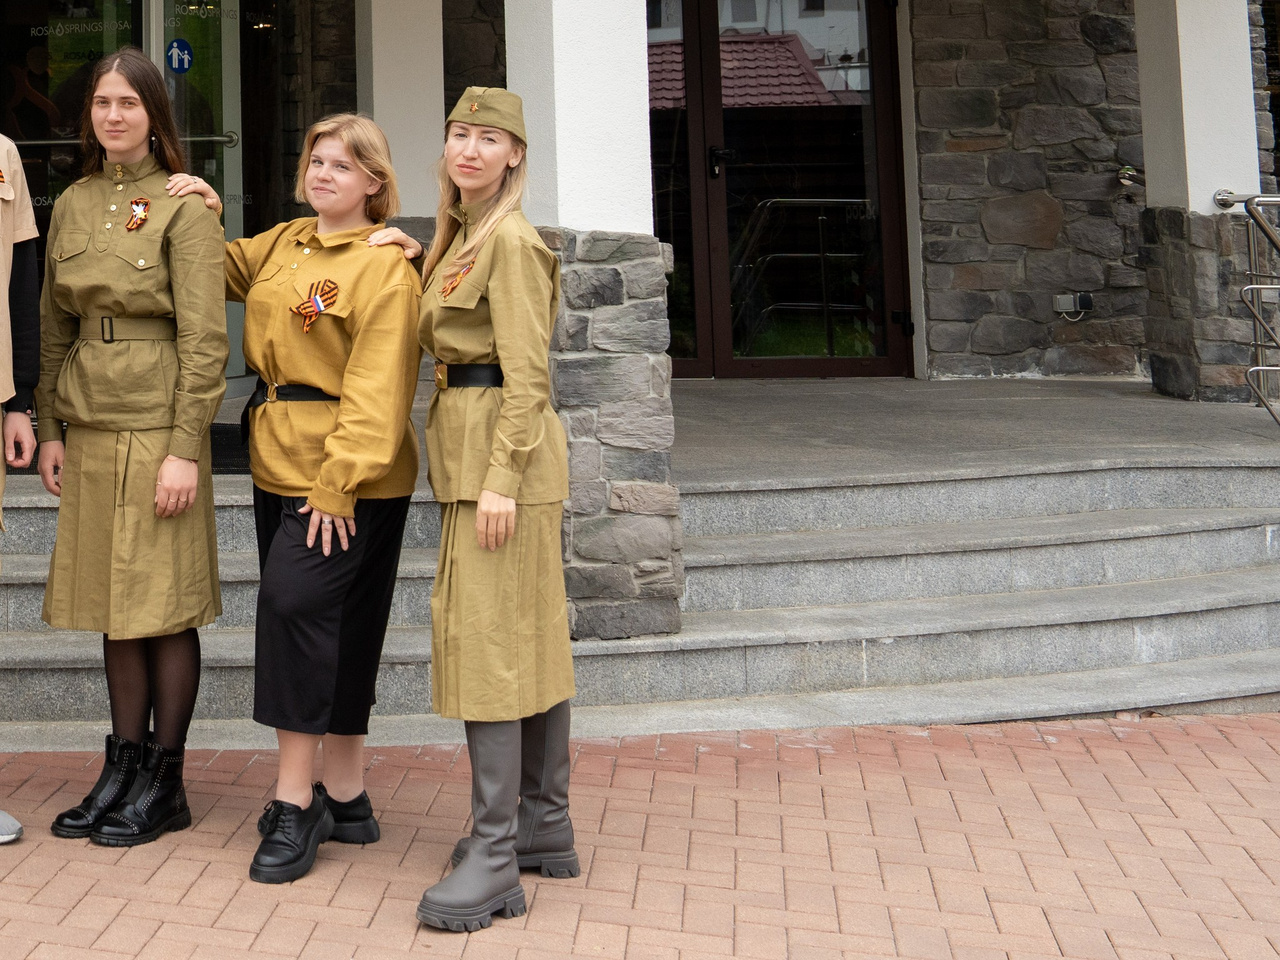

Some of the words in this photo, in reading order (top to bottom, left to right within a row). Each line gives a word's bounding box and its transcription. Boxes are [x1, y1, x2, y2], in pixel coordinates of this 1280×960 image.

[175, 4, 200, 16] ROSA
[208, 7, 238, 20] SPRINGS
[30, 26, 56, 37] ROSA
[65, 22, 103, 35] SPRINGS
[104, 20, 131, 31] ROSA
[31, 196, 54, 206] ROSA
